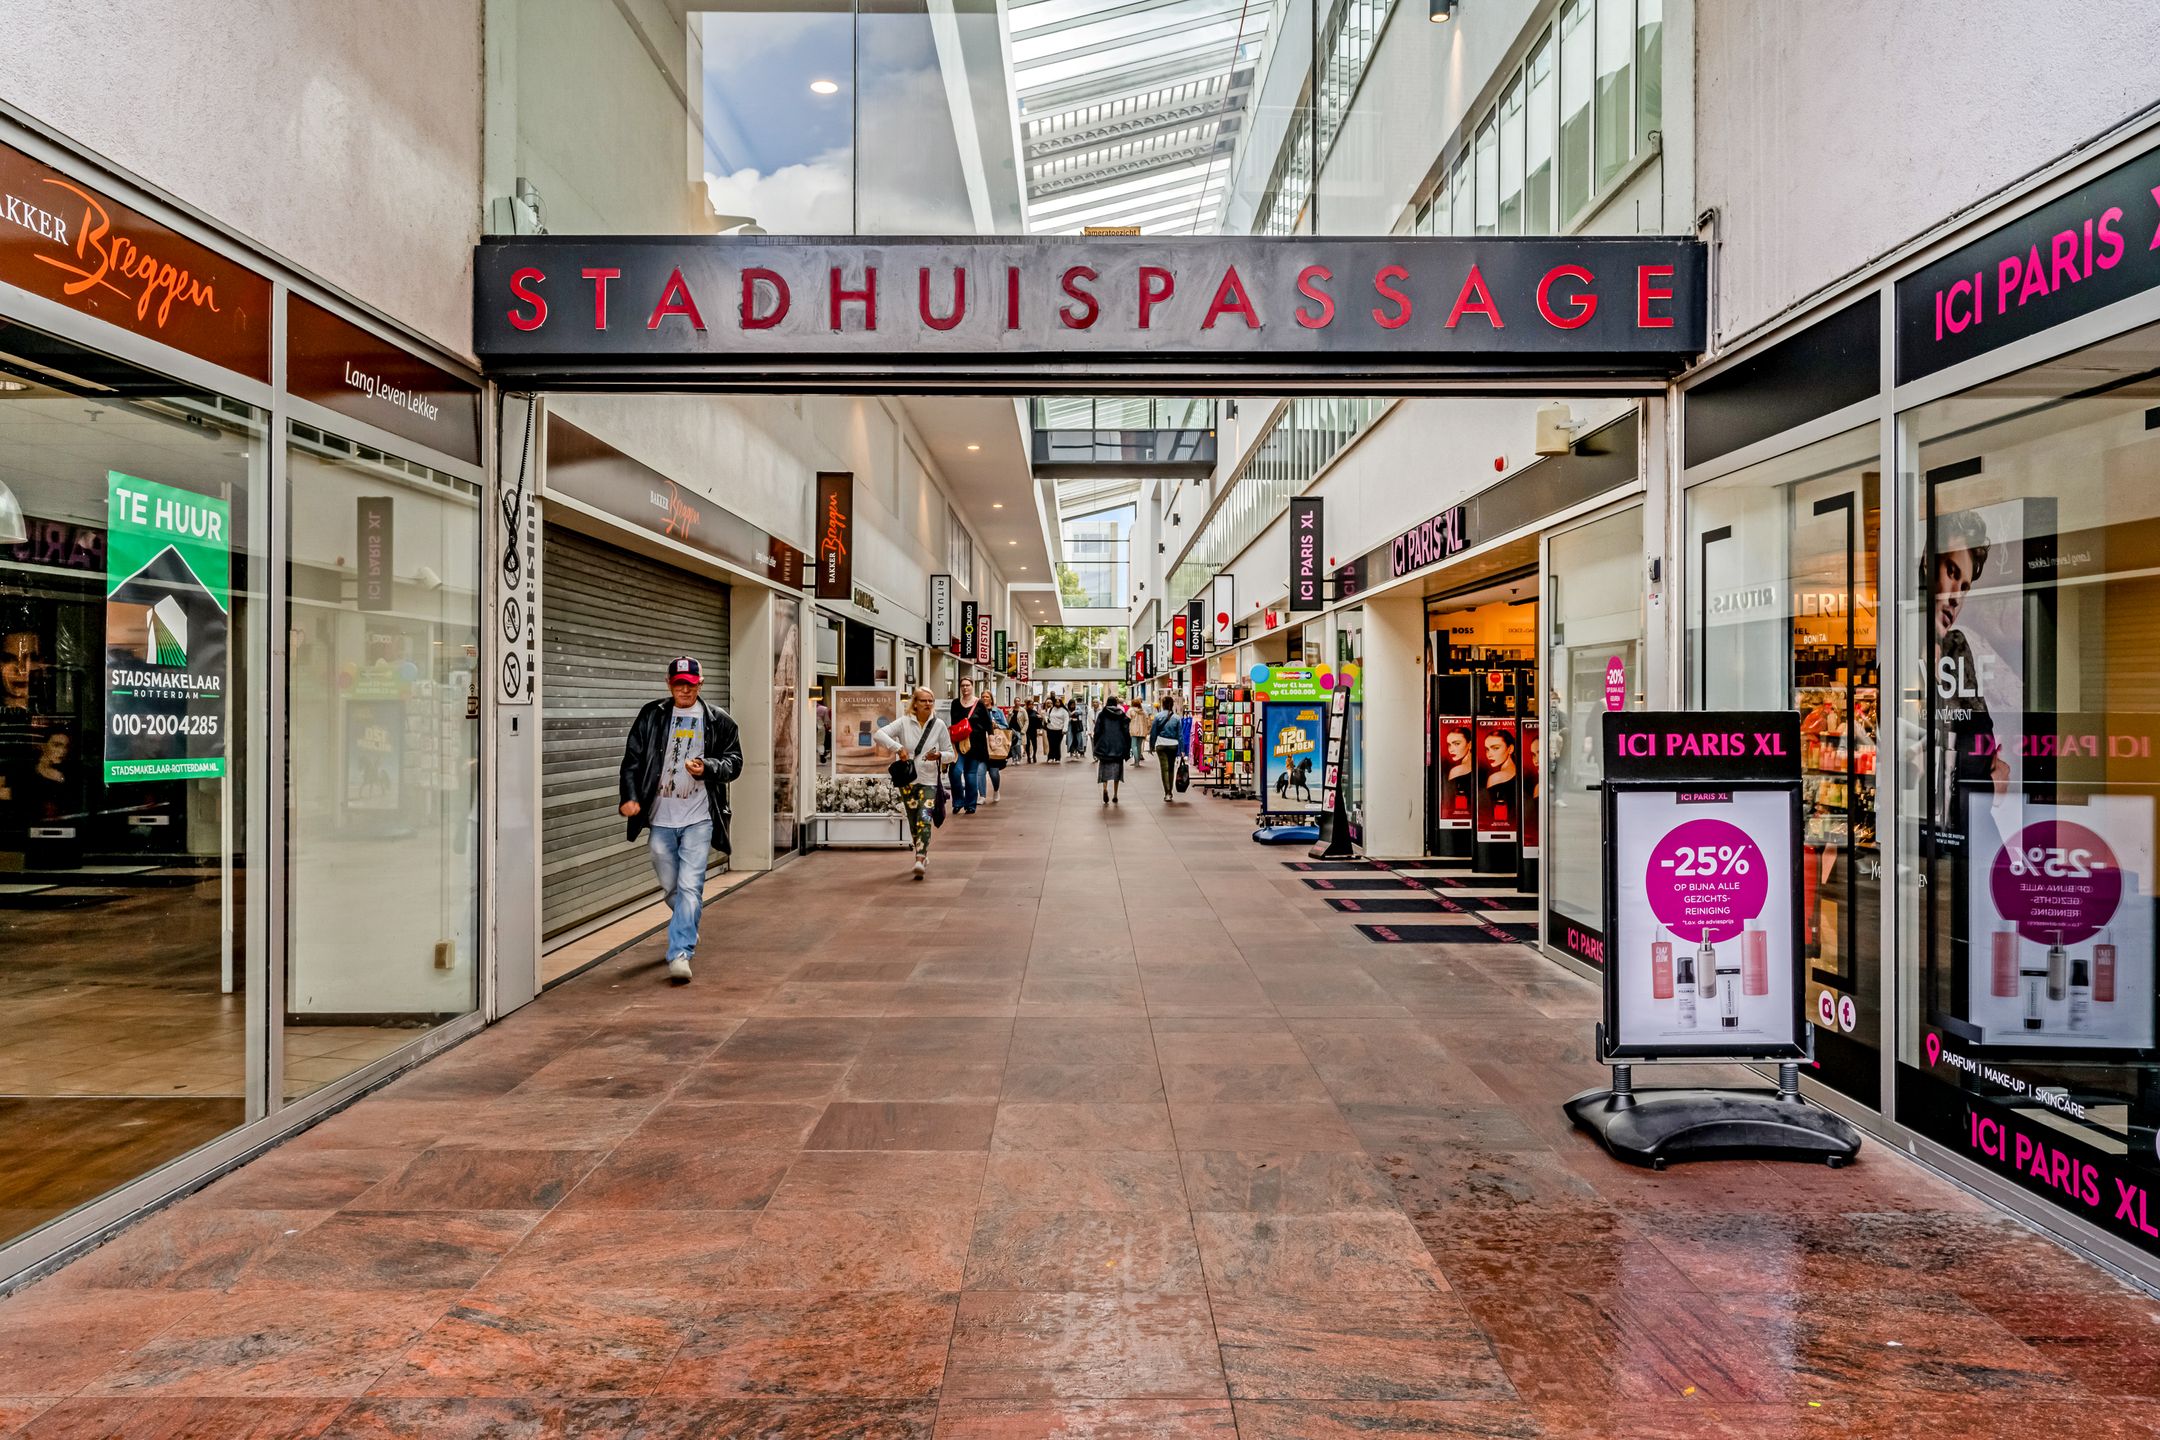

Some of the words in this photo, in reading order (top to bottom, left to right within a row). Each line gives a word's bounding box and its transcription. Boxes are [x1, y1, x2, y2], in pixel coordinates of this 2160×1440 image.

[34, 178, 221, 328] Breggen
[1935, 271, 1983, 342] ICI
[1997, 207, 2125, 315] PARIS
[506, 264, 1676, 332] STADHUISPASSAGE
[344, 361, 374, 398] Lang
[376, 374, 406, 409] Leven
[407, 394, 439, 422] Lekker
[116, 487, 148, 526] TE
[155, 499, 222, 543] HUUR
[820, 491, 848, 564] Breggen
[1300, 509, 1313, 529] XL
[1392, 536, 1406, 577] ICI
[1408, 516, 1442, 571] PARIS
[1445, 506, 1464, 556] XL
[828, 552, 836, 584] BAKKER
[1300, 535, 1314, 576] PARIS
[526, 492, 536, 705] HUISREGELS
[1300, 580, 1313, 601] ICI
[980, 620, 989, 661] BRISTOL
[1192, 618, 1200, 650] BONITA
[1020, 653, 1028, 680] HEMA
[111, 669, 221, 692] STADSMAKELAAR
[133, 689, 200, 700] ROTTERDAM
[111, 713, 218, 737] 010-2004285
[1281, 729, 1305, 745] 120
[1276, 740, 1314, 755] MILJOEN
[1618, 734, 1656, 756] ICI
[1666, 733, 1745, 757] PARIS
[1753, 733, 1787, 756] XL
[110, 760, 219, 777] STADSMAKELAAR-ROTTERDAM.NL
[1681, 793, 1692, 801] ICI
[1693, 792, 1717, 801] PARIS
[1718, 792, 1728, 801] XL
[1674, 882, 1687, 892] OP
[1688, 882, 1715, 892] BIJNA
[1717, 881, 1740, 891] ALLE
[1684, 894, 1731, 904] GEZICHTS-
[1685, 906, 1731, 916] REINIGING
[1567, 927, 1579, 951] ICI
[1942, 1050, 1976, 1074] PARFUM
[1985, 1067, 2026, 1093] MAKE-UP
[2035, 1087, 2085, 1120] SKINCARE
[1971, 1111, 2006, 1162] ICI
[2016, 1132, 2100, 1207] PARIS
[2115, 1178, 2159, 1238] XL
